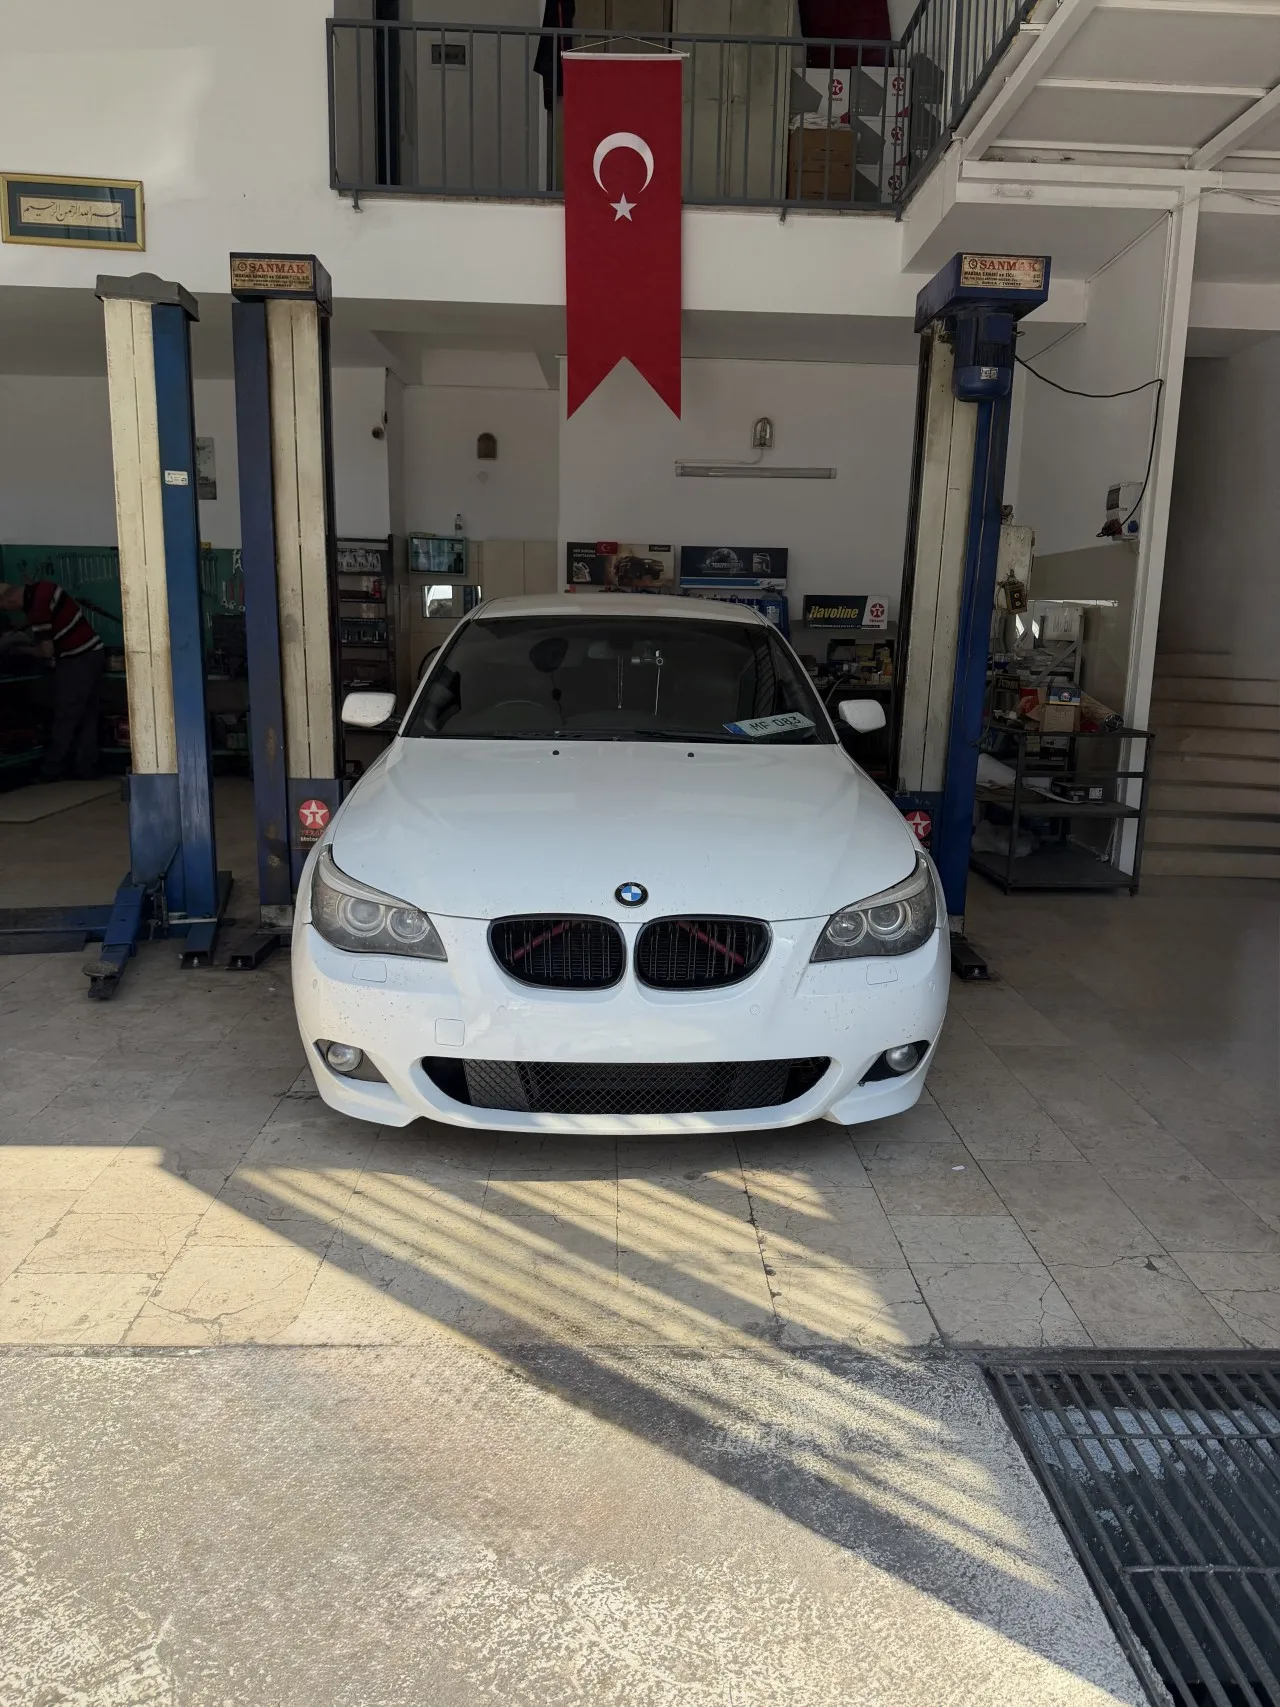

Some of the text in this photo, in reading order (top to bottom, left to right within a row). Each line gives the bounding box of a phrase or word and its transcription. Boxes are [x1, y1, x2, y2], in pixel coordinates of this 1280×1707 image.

[249, 262, 306, 274] SANMAK
[979, 260, 1039, 272] SANMAK
[809, 605, 859, 619] Havoline
[749, 716, 801, 731] MF 083
